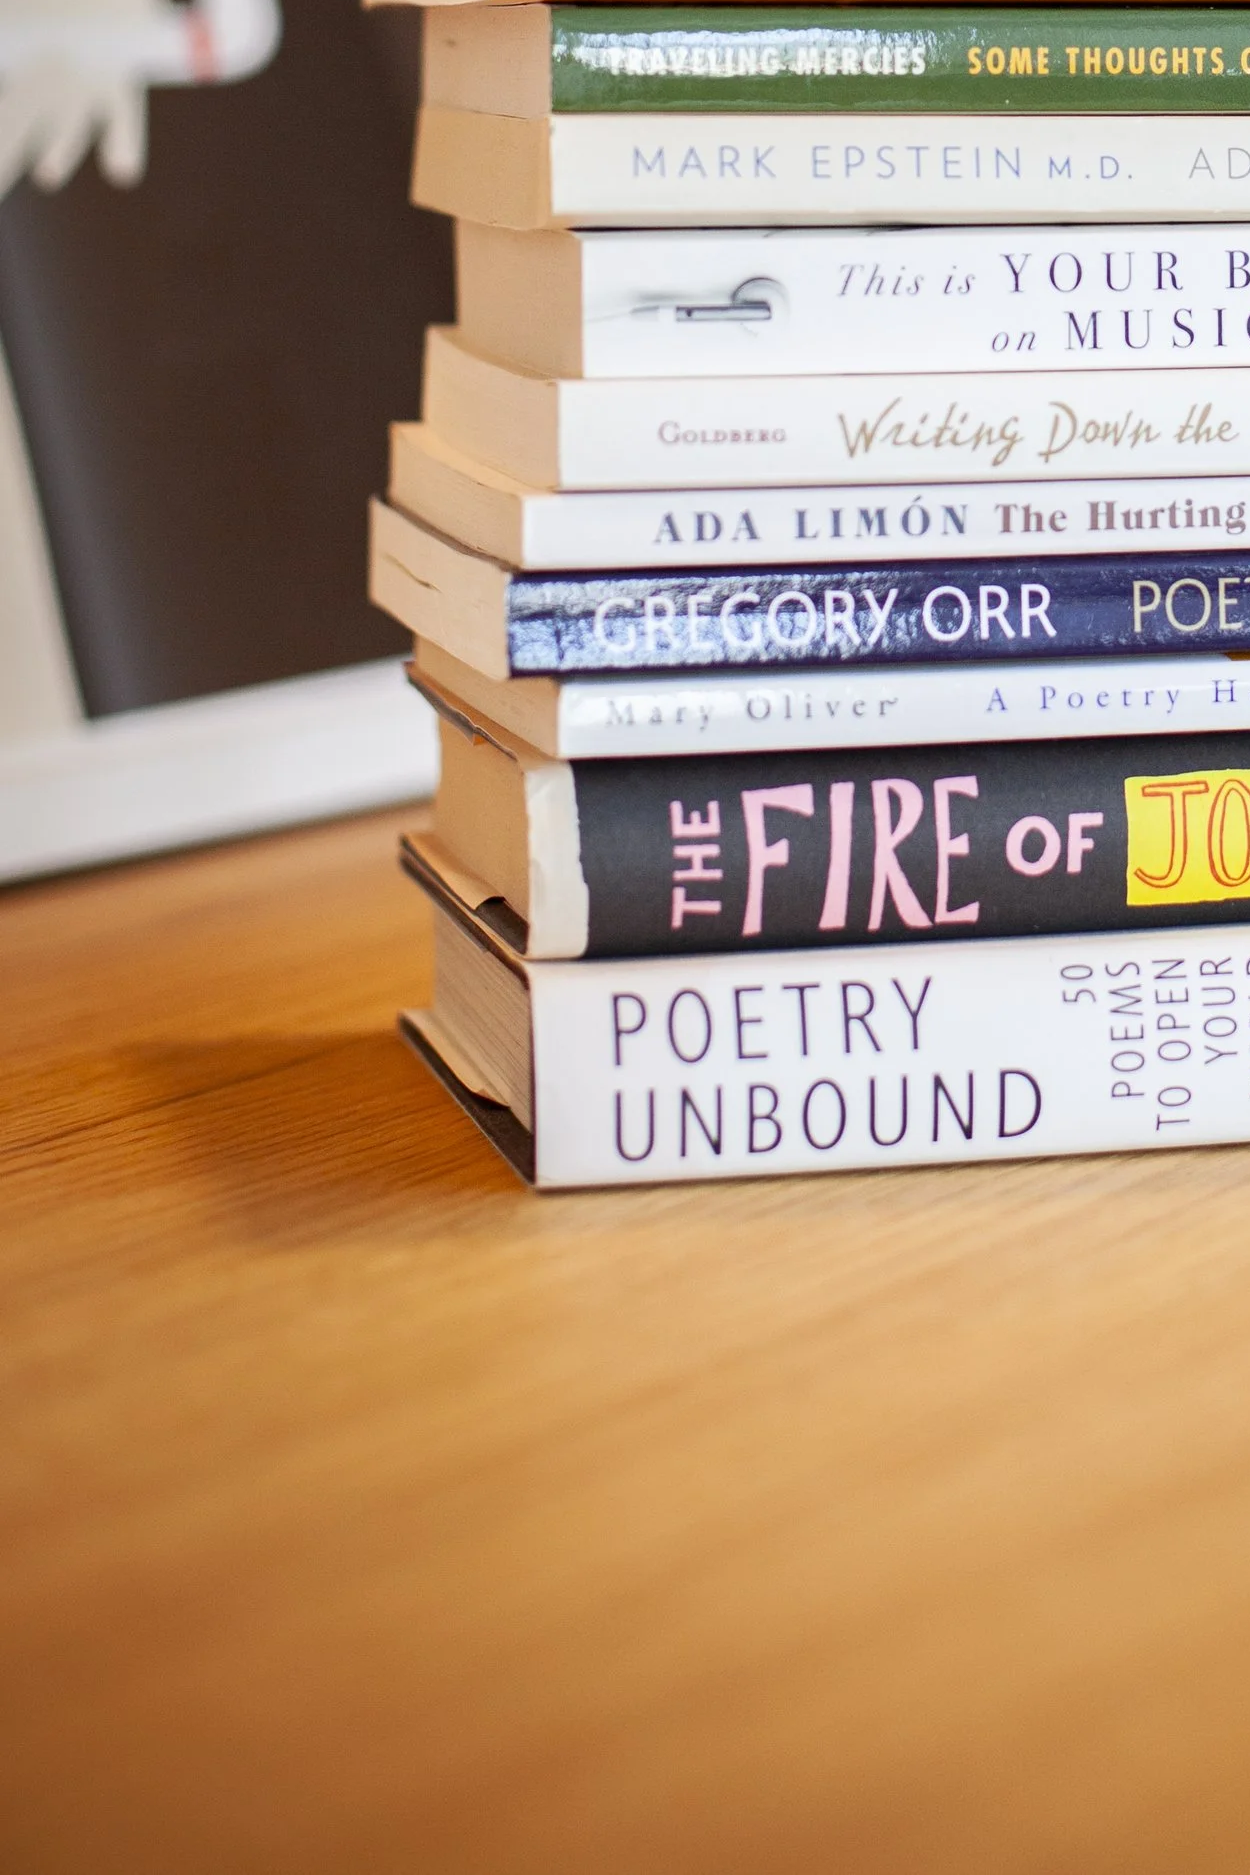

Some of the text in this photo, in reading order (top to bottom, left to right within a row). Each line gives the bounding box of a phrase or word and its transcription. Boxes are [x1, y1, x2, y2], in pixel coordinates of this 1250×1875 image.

[608, 46, 927, 76] TRAVELING MERCIES
[967, 46, 1050, 75] SOME
[1065, 46, 1225, 75] THOUGHTS
[632, 145, 1134, 180] MARK EPSTEIN M.D.
[836, 263, 925, 298] This
[944, 265, 977, 295] is
[1000, 249, 1184, 294] YOUR
[990, 329, 1037, 353] on
[657, 421, 788, 445] GOLDBERG
[838, 396, 1026, 467] Writing
[1037, 400, 1162, 464] Down
[1173, 402, 1240, 445] the
[654, 509, 762, 545] ADA
[794, 494, 970, 541] LIMÓN
[994, 503, 1069, 535] The
[1087, 498, 1247, 536] Hurting
[593, 583, 1059, 653] GREGORY ORR
[605, 691, 899, 732] Mary Oliver
[986, 686, 1009, 713] A
[1040, 685, 1180, 713] Poetry
[669, 800, 723, 931] THE
[741, 775, 980, 937] FIRE
[1005, 811, 1105, 876] OF
[1060, 963, 1097, 1005] 50
[610, 975, 933, 1067] POETRY
[1105, 960, 1146, 1099] POEMS
[1199, 955, 1239, 1065] YOUR
[1152, 957, 1192, 1132] TO OPEN
[615, 1067, 1043, 1163] UNBOUND
